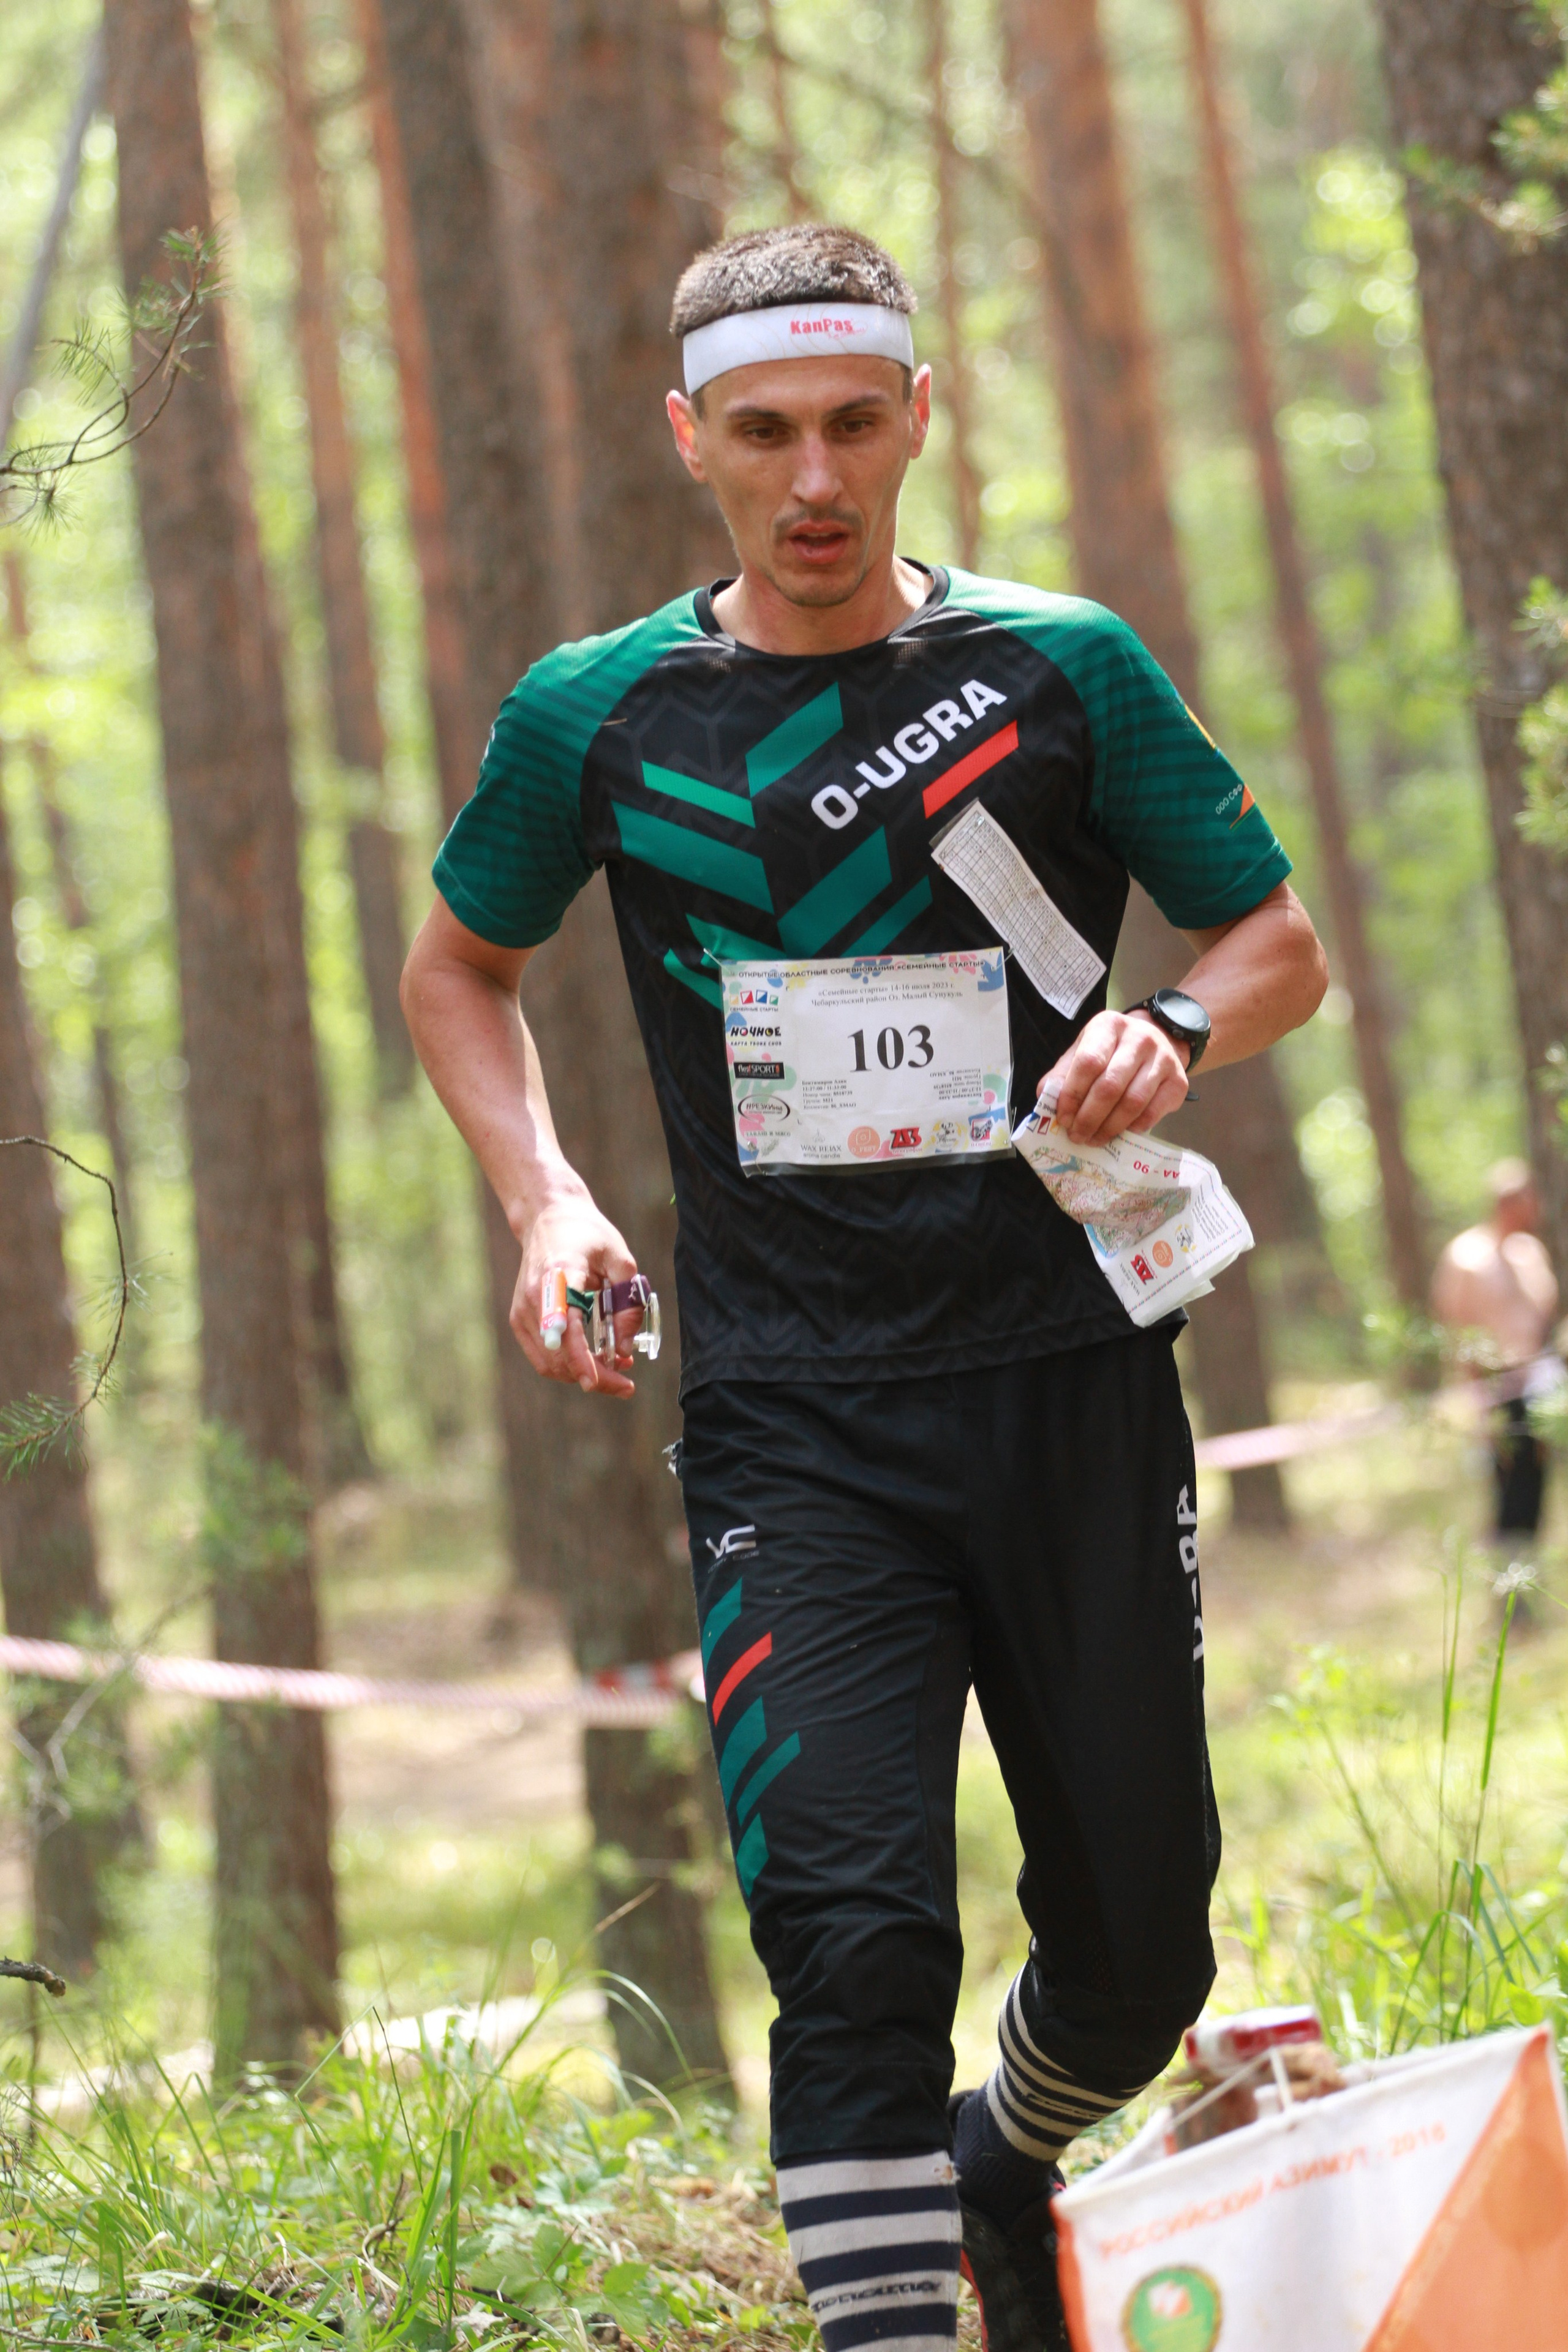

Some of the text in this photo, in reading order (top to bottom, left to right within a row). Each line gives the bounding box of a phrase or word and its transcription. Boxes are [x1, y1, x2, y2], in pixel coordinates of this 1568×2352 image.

[790, 317, 854, 335] KanPas
[811, 679, 1008, 830] O-UGRA
[780, 969, 828, 978] ОБЛАСТНЫЕ
[830, 964, 894, 975] СОРЕВНОВАНИЯ
[897, 962, 946, 970] «СЕМЕЙНЫЕ
[812, 997, 864, 1008] Чебаркульский
[866, 995, 886, 1005] район
[929, 991, 963, 1000] Сунукуль
[730, 1025, 782, 1037] НОЧНОЕ
[848, 1025, 934, 1072] 103
[1133, 1159, 1150, 1174] 90
[1270, 2145, 1370, 2194] АЗИМУТ
